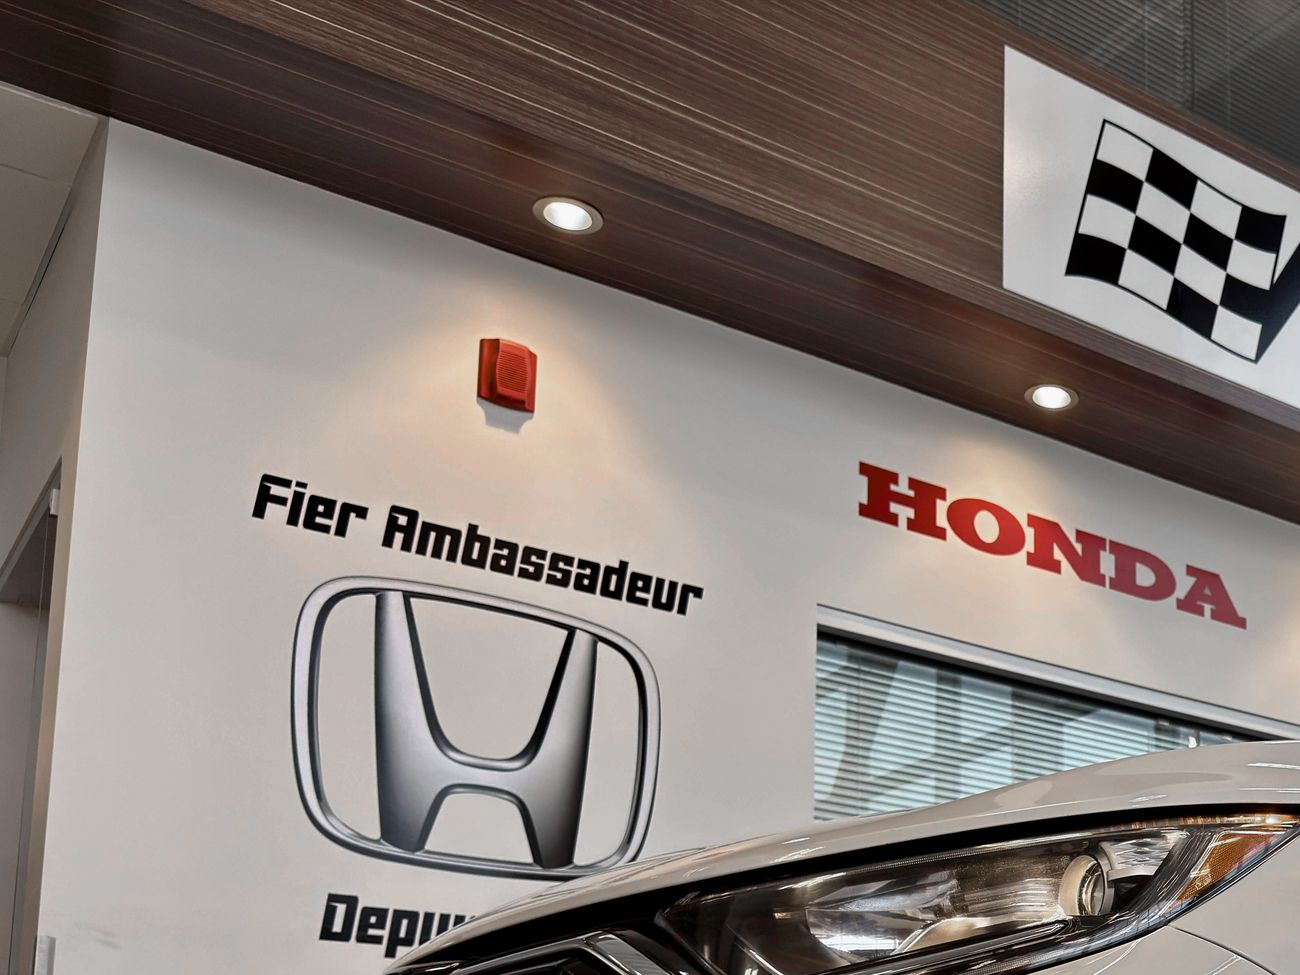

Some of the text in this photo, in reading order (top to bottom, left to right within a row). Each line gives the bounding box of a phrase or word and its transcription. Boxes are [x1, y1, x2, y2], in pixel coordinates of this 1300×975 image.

[251, 473, 705, 617] Fier Ambassadeur
[859, 462, 1245, 628] HONDA
[318, 892, 475, 960] Depu
